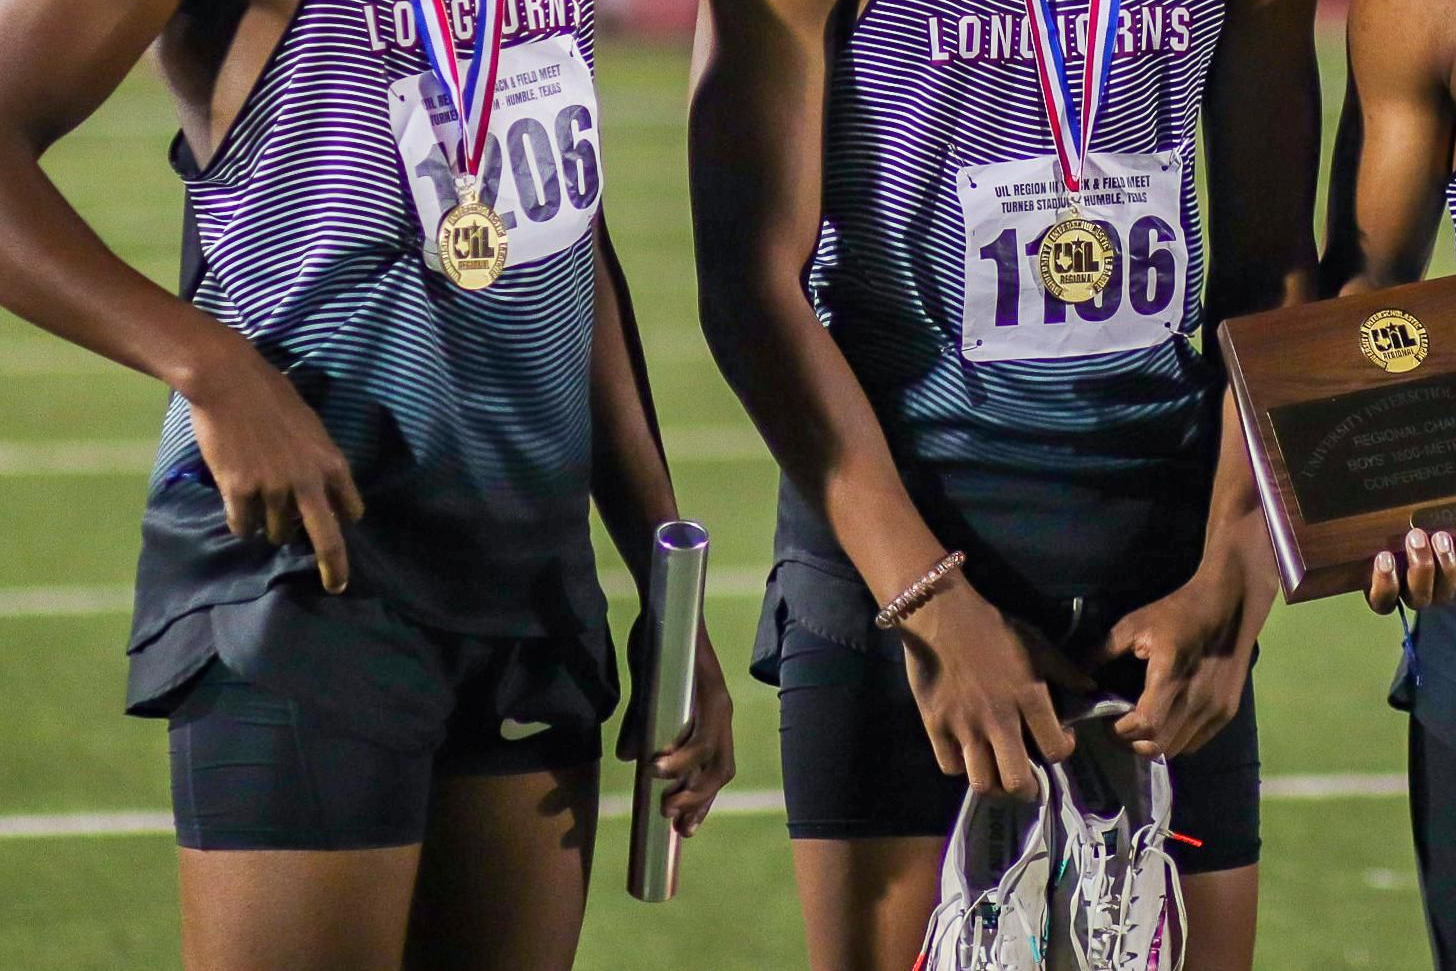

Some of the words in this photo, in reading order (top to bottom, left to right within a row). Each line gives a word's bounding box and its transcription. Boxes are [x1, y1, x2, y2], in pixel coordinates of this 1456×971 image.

[538, 64, 561, 82] MEET
[538, 83, 562, 98] TEXAS
[995, 185, 1011, 198] UIL
[1014, 182, 1046, 196] REGION
[1093, 178, 1100, 190] &
[1103, 176, 1125, 189] FIELD
[1001, 200, 1034, 213] TURNER
[1352, 423, 1423, 446] REGIONAL
[1363, 462, 1456, 491] CONFERENCE
